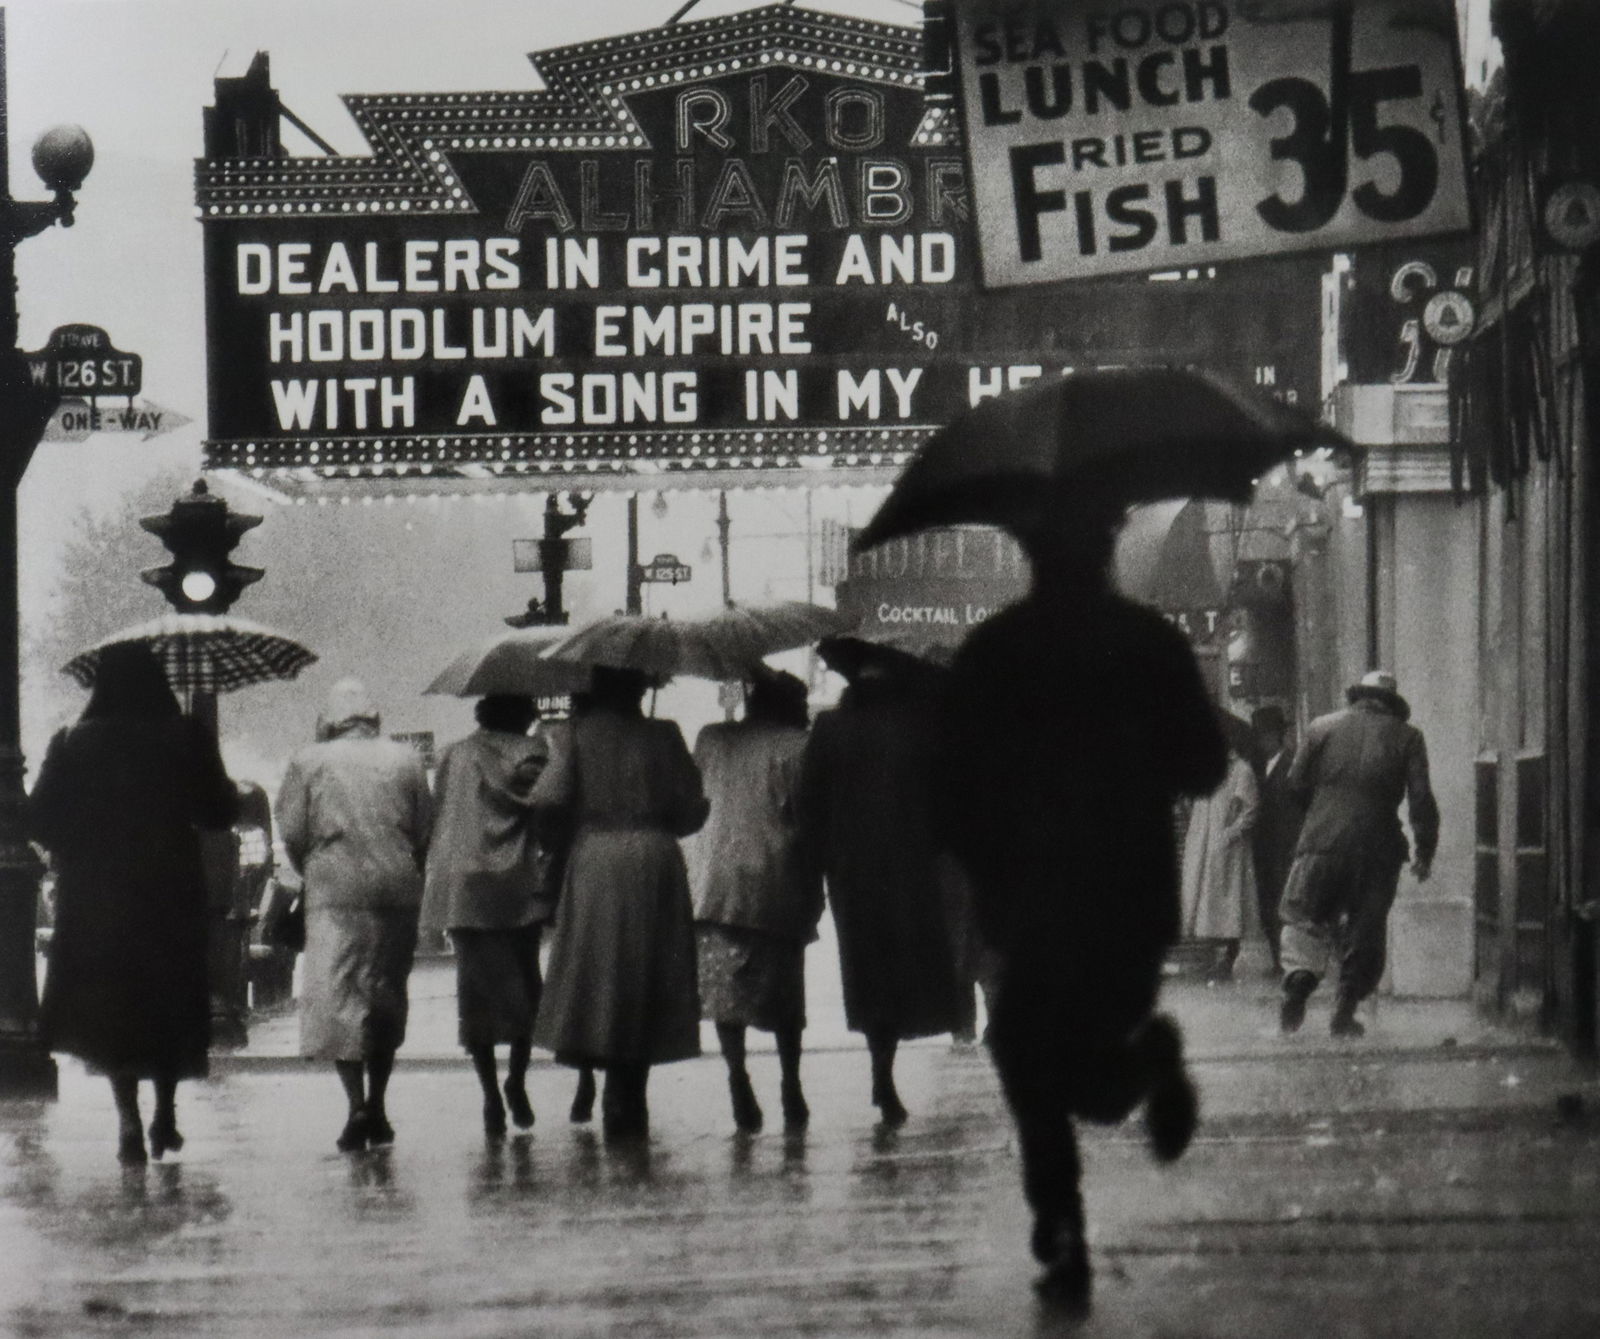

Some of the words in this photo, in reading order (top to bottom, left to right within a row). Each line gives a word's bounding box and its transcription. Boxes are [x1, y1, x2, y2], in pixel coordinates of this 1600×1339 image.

[973, 18, 1067, 66] SEA
[1087, 0, 1228, 54] FOOD
[675, 73, 885, 153] RKO
[978, 45, 1231, 127] LUNCH
[504, 156, 968, 233] ALHAMBR
[1009, 143, 1221, 262] FISH
[237, 238, 521, 295] DEALERS
[546, 237, 600, 290] IN
[626, 234, 809, 288] CRIME
[835, 232, 956, 285] AND
[269, 307, 555, 363] HOODLUM
[595, 302, 812, 357] EMPIRE
[886, 303, 938, 350] ALSO
[57, 359, 96, 387] 126
[270, 376, 415, 430] WITH
[456, 374, 497, 426] A
[540, 371, 698, 425] SONG
[745, 369, 799, 421] IN
[837, 367, 923, 420] MY
[1256, 366, 1275, 385] IN
[878, 603, 959, 625] COCKTAIL
